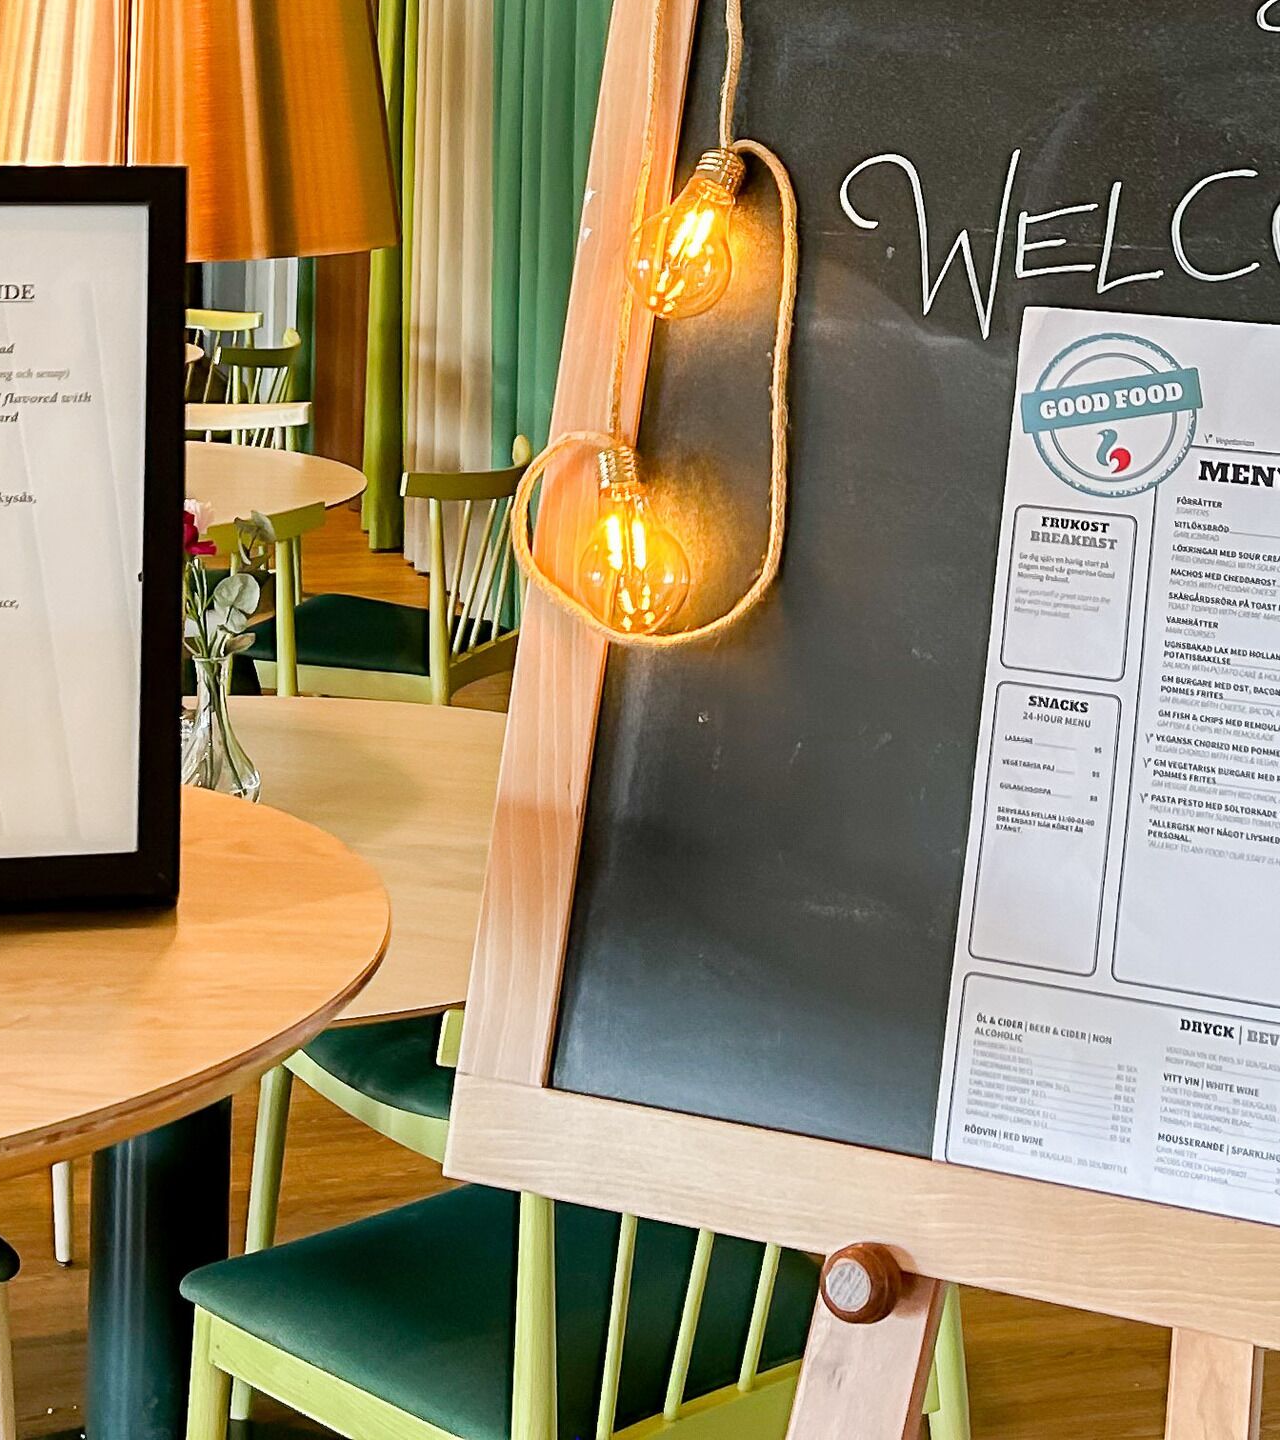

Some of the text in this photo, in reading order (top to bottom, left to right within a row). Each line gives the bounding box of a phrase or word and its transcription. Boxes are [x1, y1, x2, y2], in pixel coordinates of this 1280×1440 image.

[1, 391, 59, 408] flavored
[61, 391, 92, 403] with
[1039, 382, 1184, 420] GOOD FOOD
[1041, 515, 1110, 534] FRUKOST
[1029, 530, 1118, 551] BREAKFAST
[1219, 549, 1237, 559] MED
[1238, 551, 1261, 561] SOUR
[1170, 568, 1222, 581] NACHOS MED
[1250, 601, 1277, 612] TOAST
[1229, 647, 1248, 657] MED
[1214, 681, 1232, 691] MED
[1028, 695, 1089, 714] SNACKS
[1022, 711, 1092, 729] 24-HOUR MENU
[1172, 711, 1191, 721] FISH
[1225, 718, 1243, 728] MED
[1231, 743, 1250, 754] MED
[1150, 793, 1177, 805] PASTA
[1205, 801, 1223, 811] MED
[1224, 804, 1278, 819] SOLTORKADE
[974, 1026, 1024, 1043] ALCOHOLIC
[997, 1017, 1023, 1030] CIDER
[1029, 1022, 1051, 1034] BEER
[1060, 1028, 1087, 1041] CIDER
[1092, 1033, 1113, 1045] NON
[1179, 1018, 1235, 1040] DRYCK
[1163, 1072, 1183, 1084] VITT
[1205, 1080, 1235, 1093] WHITE
[1236, 1085, 1259, 1098] WINE
[964, 1123, 1044, 1147] RÖDVIN RED WINE
[1157, 1132, 1225, 1153] MOUSSERANDE
